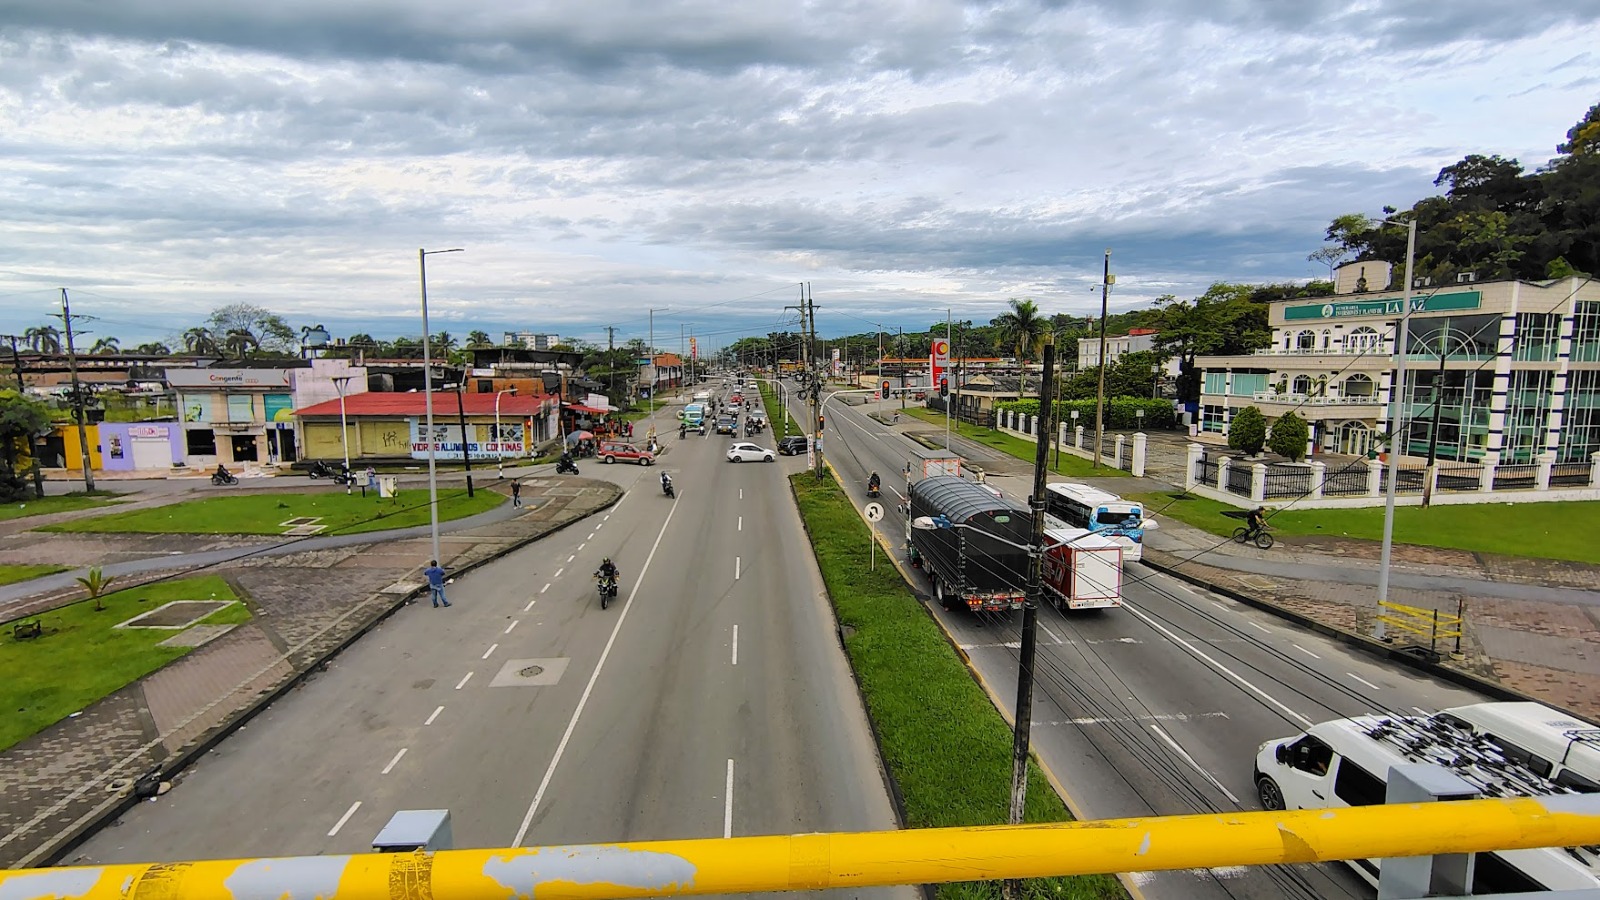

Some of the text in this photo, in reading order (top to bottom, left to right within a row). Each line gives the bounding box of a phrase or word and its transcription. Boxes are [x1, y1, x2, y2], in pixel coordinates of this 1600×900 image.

[1386, 298, 1426, 313] LA AZ
[412, 442, 440, 451] VIDRS
